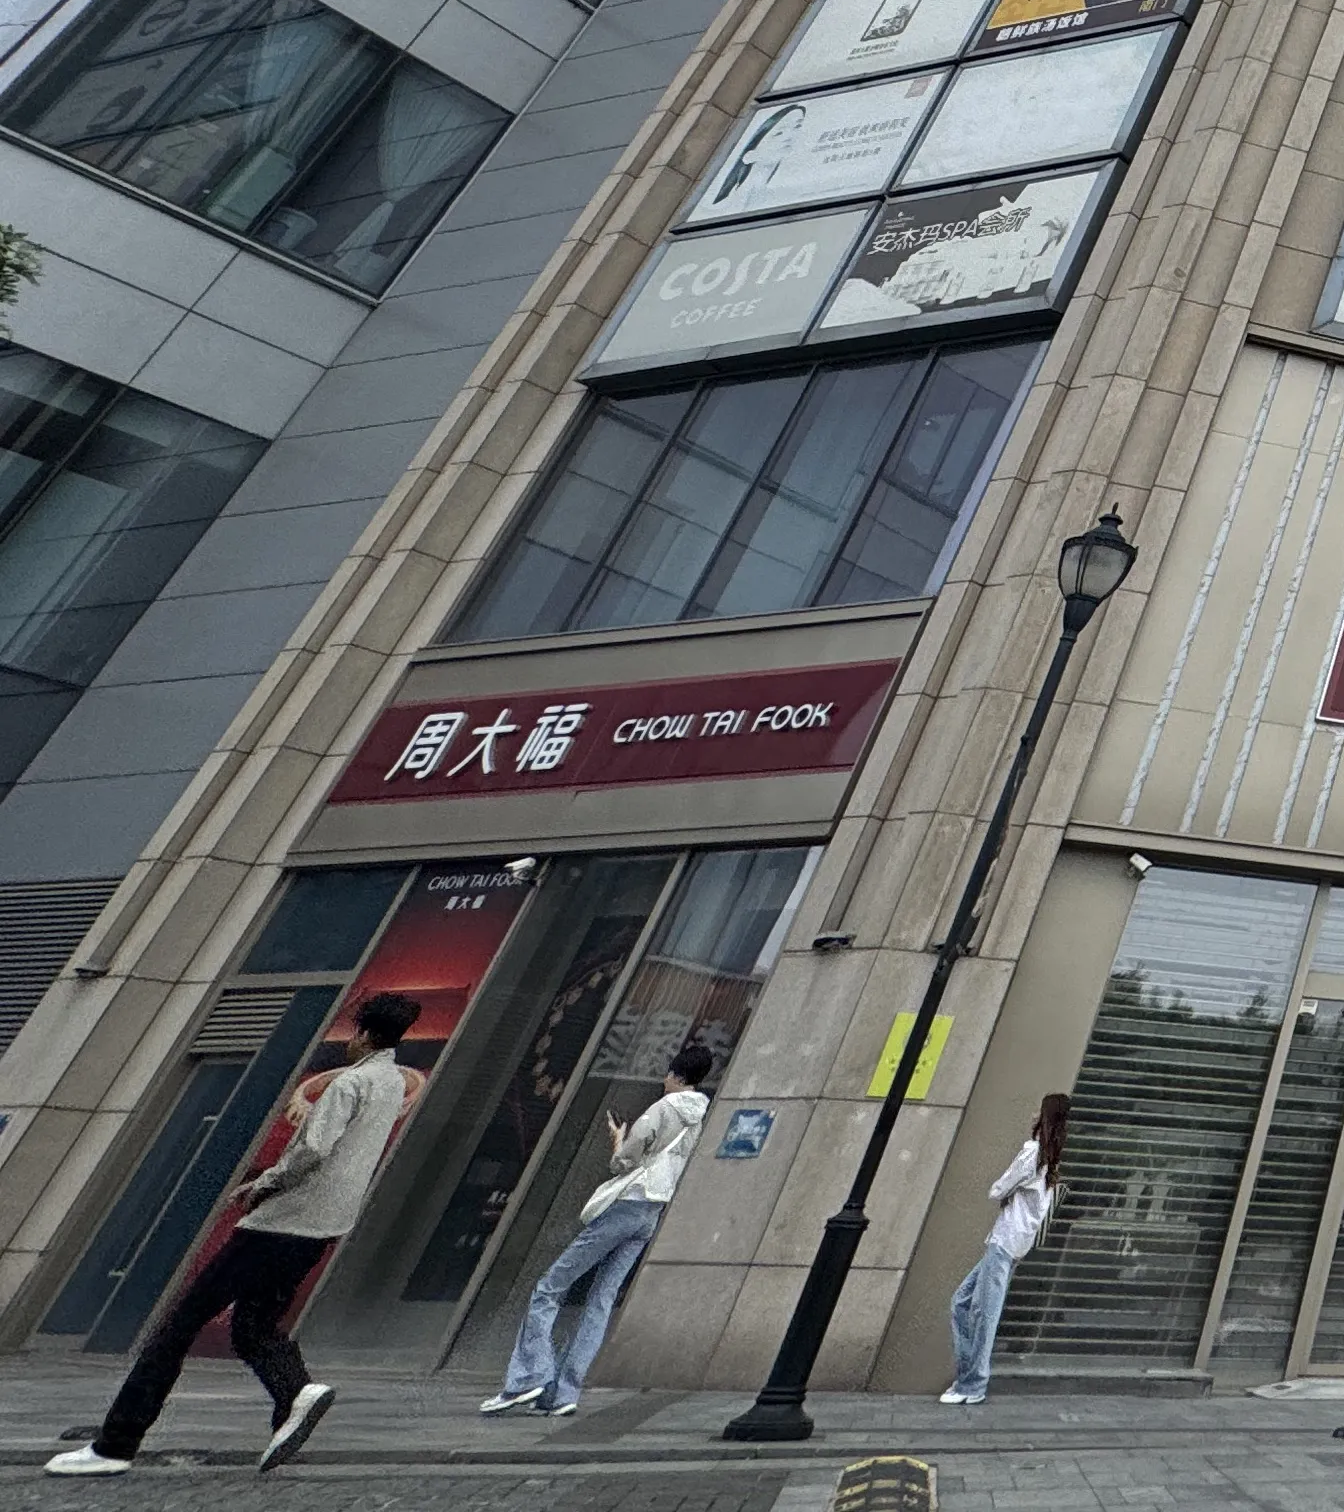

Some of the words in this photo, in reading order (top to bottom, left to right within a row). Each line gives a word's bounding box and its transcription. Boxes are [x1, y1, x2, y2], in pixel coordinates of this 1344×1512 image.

[866, 206, 1032, 256] 安杰玛SPA会所
[659, 242, 819, 301] COSTA
[671, 298, 764, 329] COFFEE
[384, 702, 593, 782] 周大福
[612, 712, 698, 744] CHOW
[698, 708, 749, 737] TAI
[750, 701, 836, 734] FOOK
[427, 875, 470, 891] CHOW
[469, 873, 492, 888] TAI
